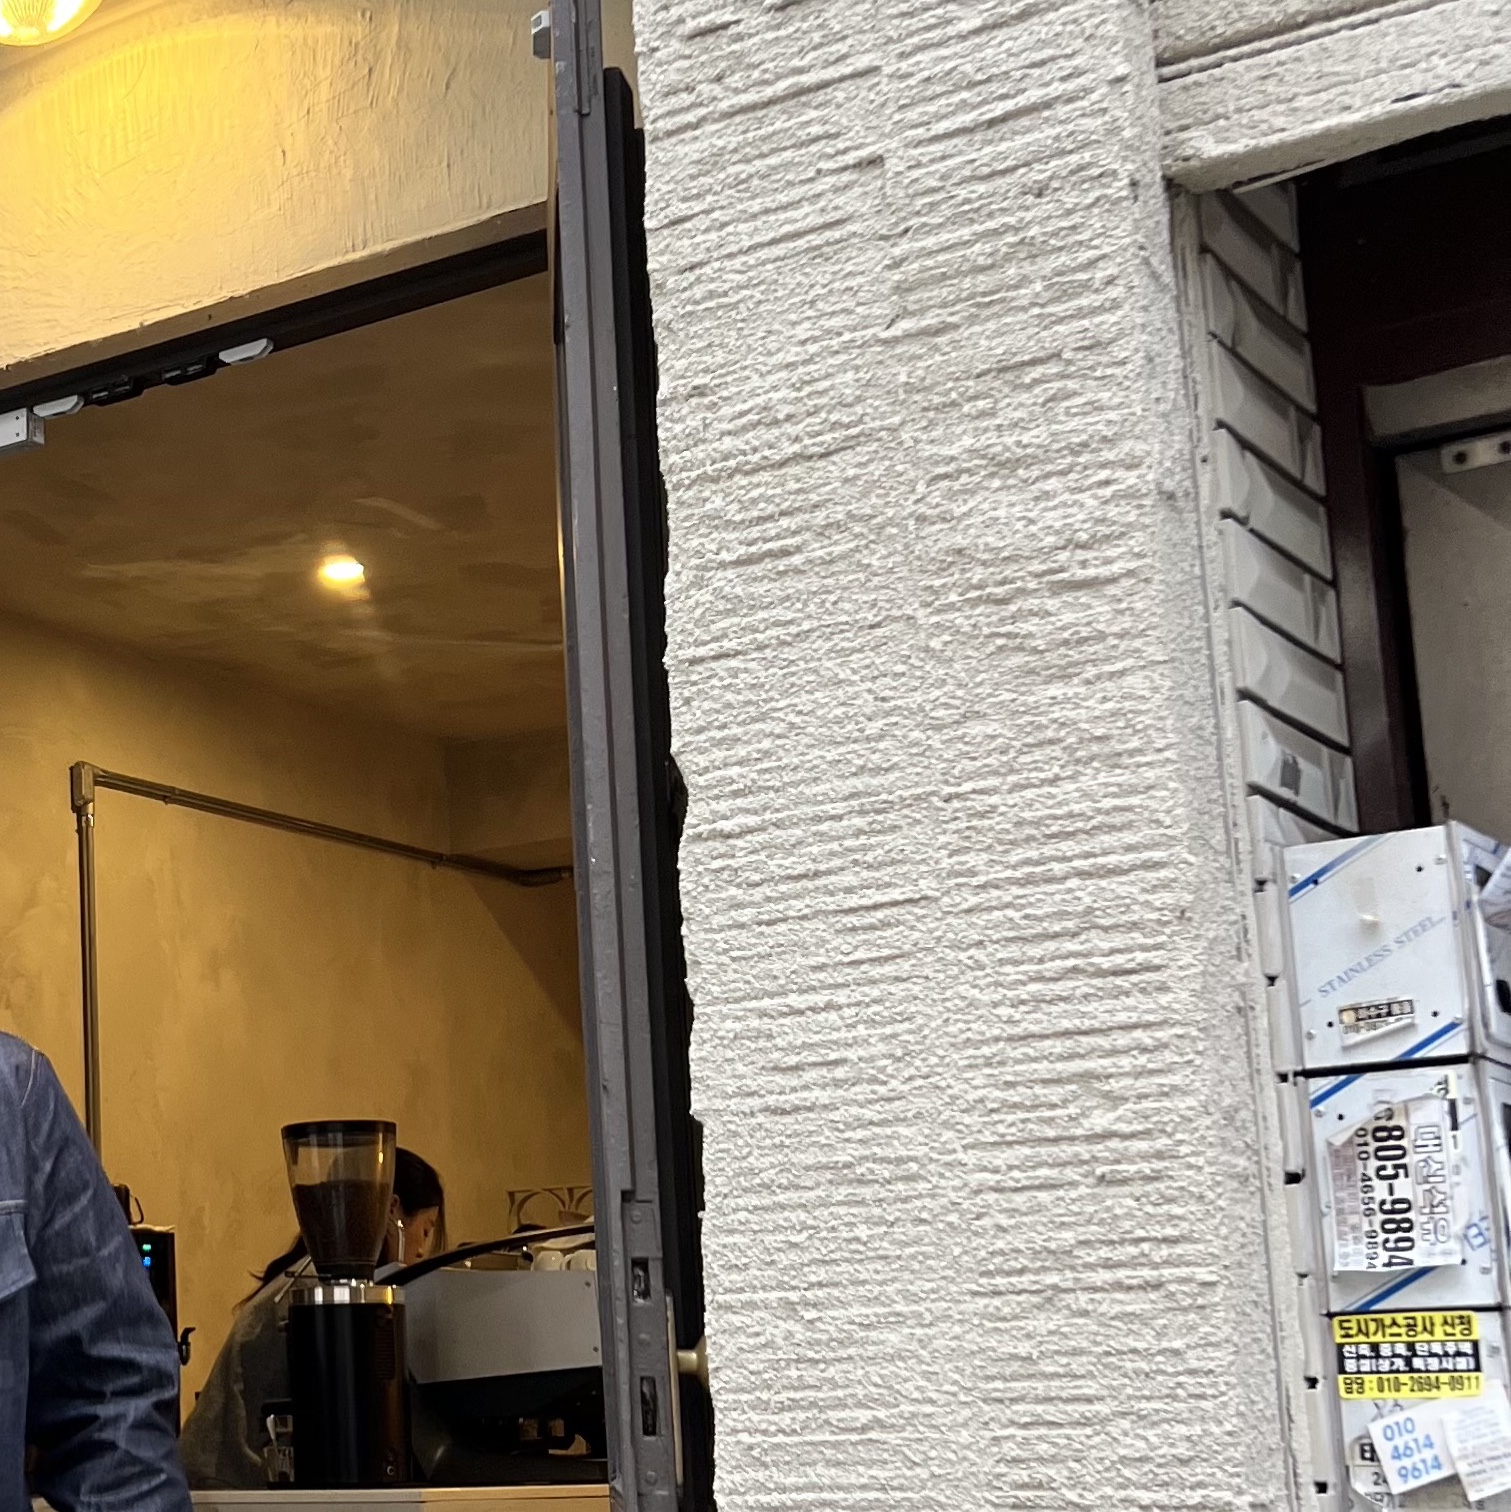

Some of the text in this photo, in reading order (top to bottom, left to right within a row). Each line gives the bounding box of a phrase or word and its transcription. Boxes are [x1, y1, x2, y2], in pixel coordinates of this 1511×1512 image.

[1317, 916, 1436, 998] STAINLESS STEEL
[1355, 1127, 1379, 1270] 010-4656-9894
[1372, 1125, 1416, 1268] 805-9894
[1338, 1314, 1473, 1339] 도시가스공사 신청
[1383, 1417, 1415, 1441] 010
[1391, 1433, 1434, 1461] 4614
[1397, 1454, 1442, 1484] 9614
